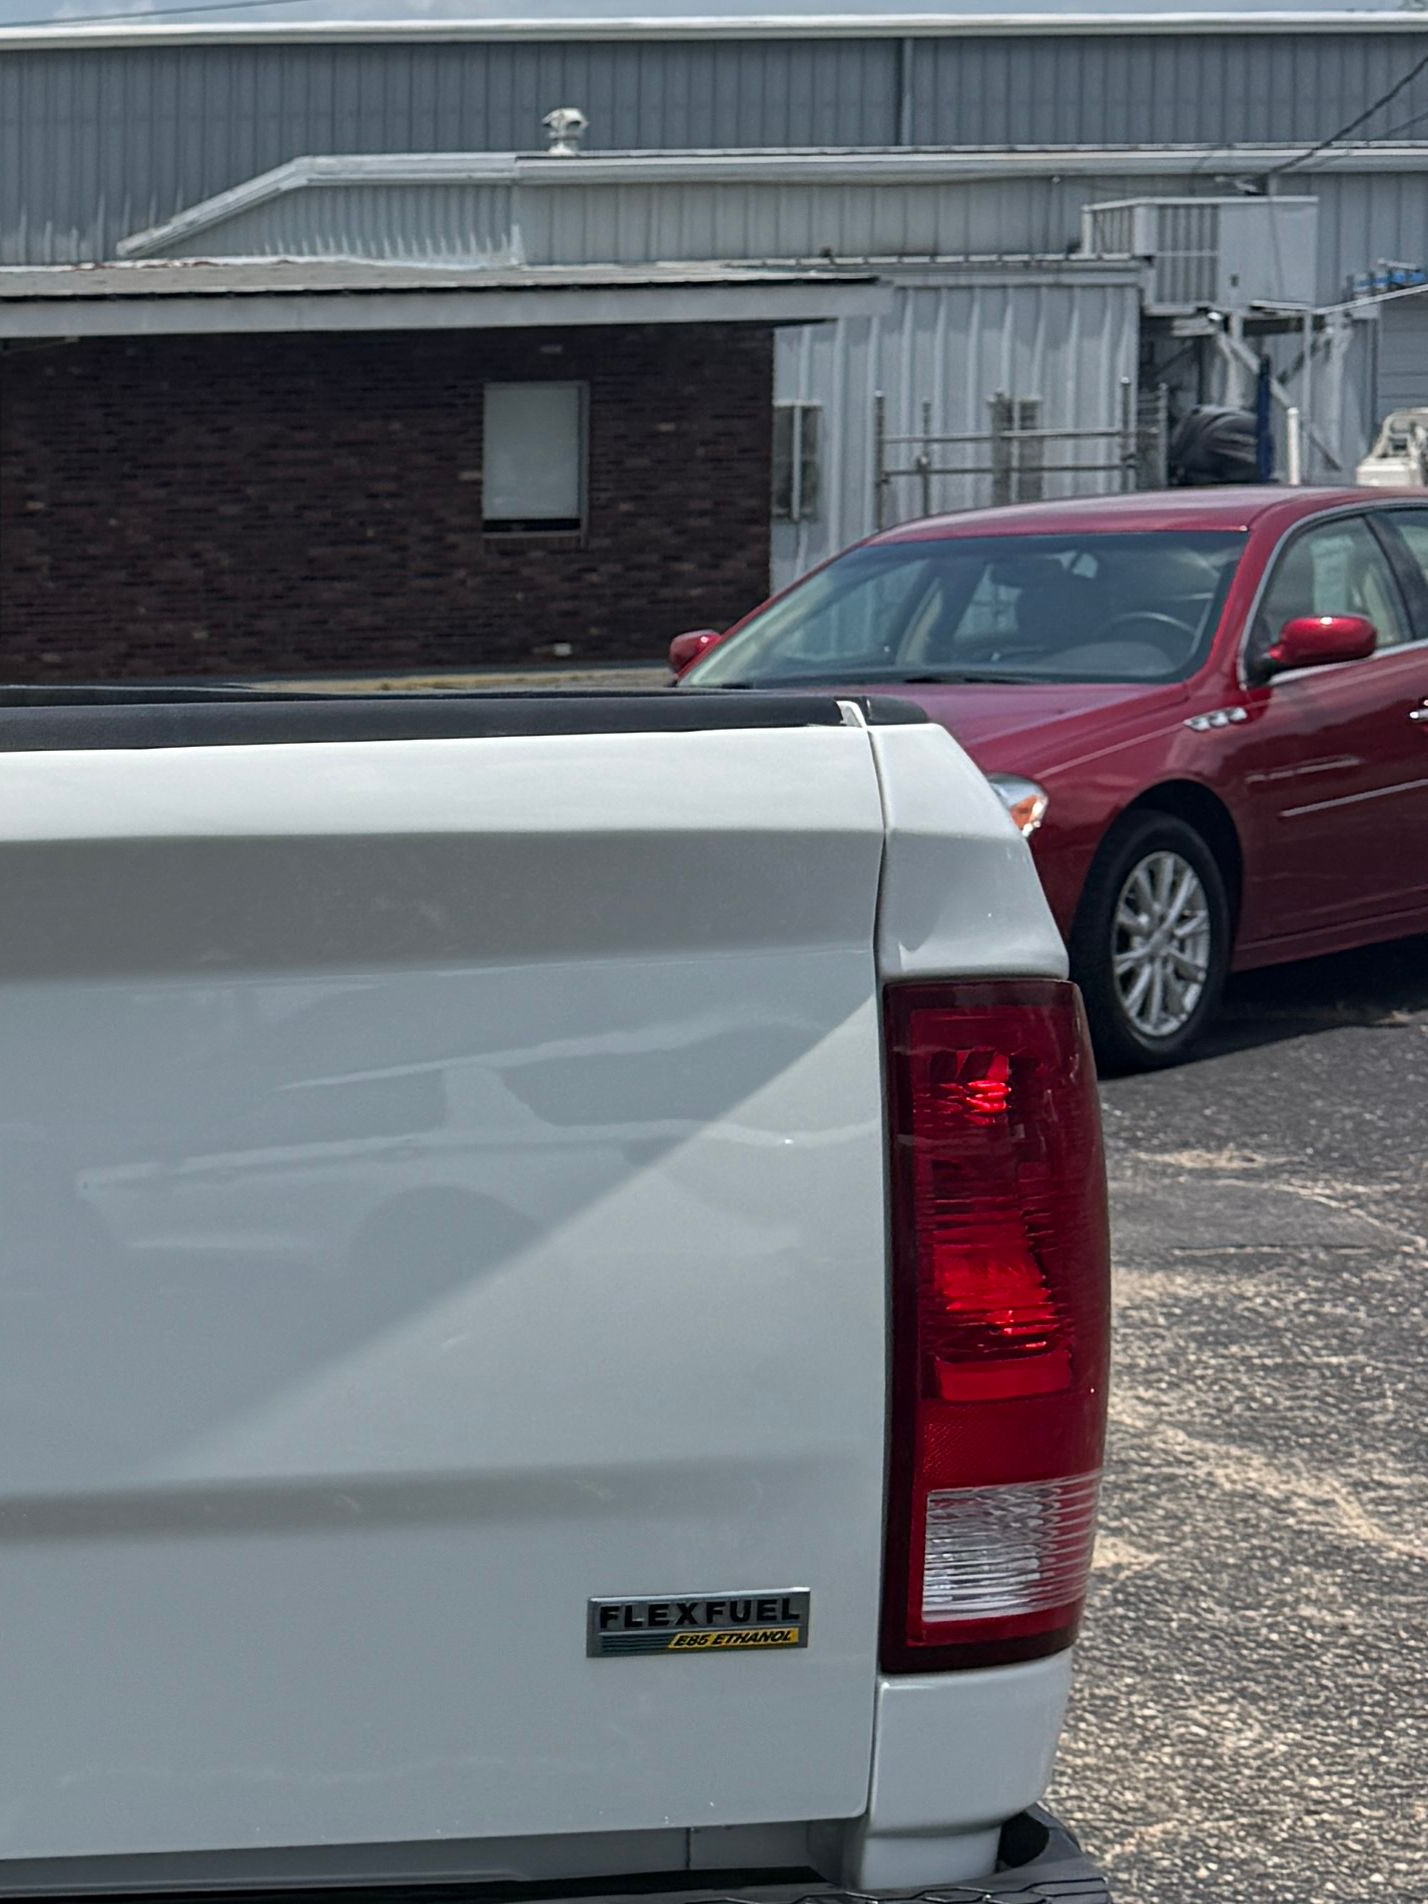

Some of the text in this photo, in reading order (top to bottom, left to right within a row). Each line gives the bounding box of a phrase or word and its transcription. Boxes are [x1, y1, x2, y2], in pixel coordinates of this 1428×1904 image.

[599, 1597, 800, 1629] FLEXFUEL
[674, 1630, 792, 1647] E85 ETHANOL
